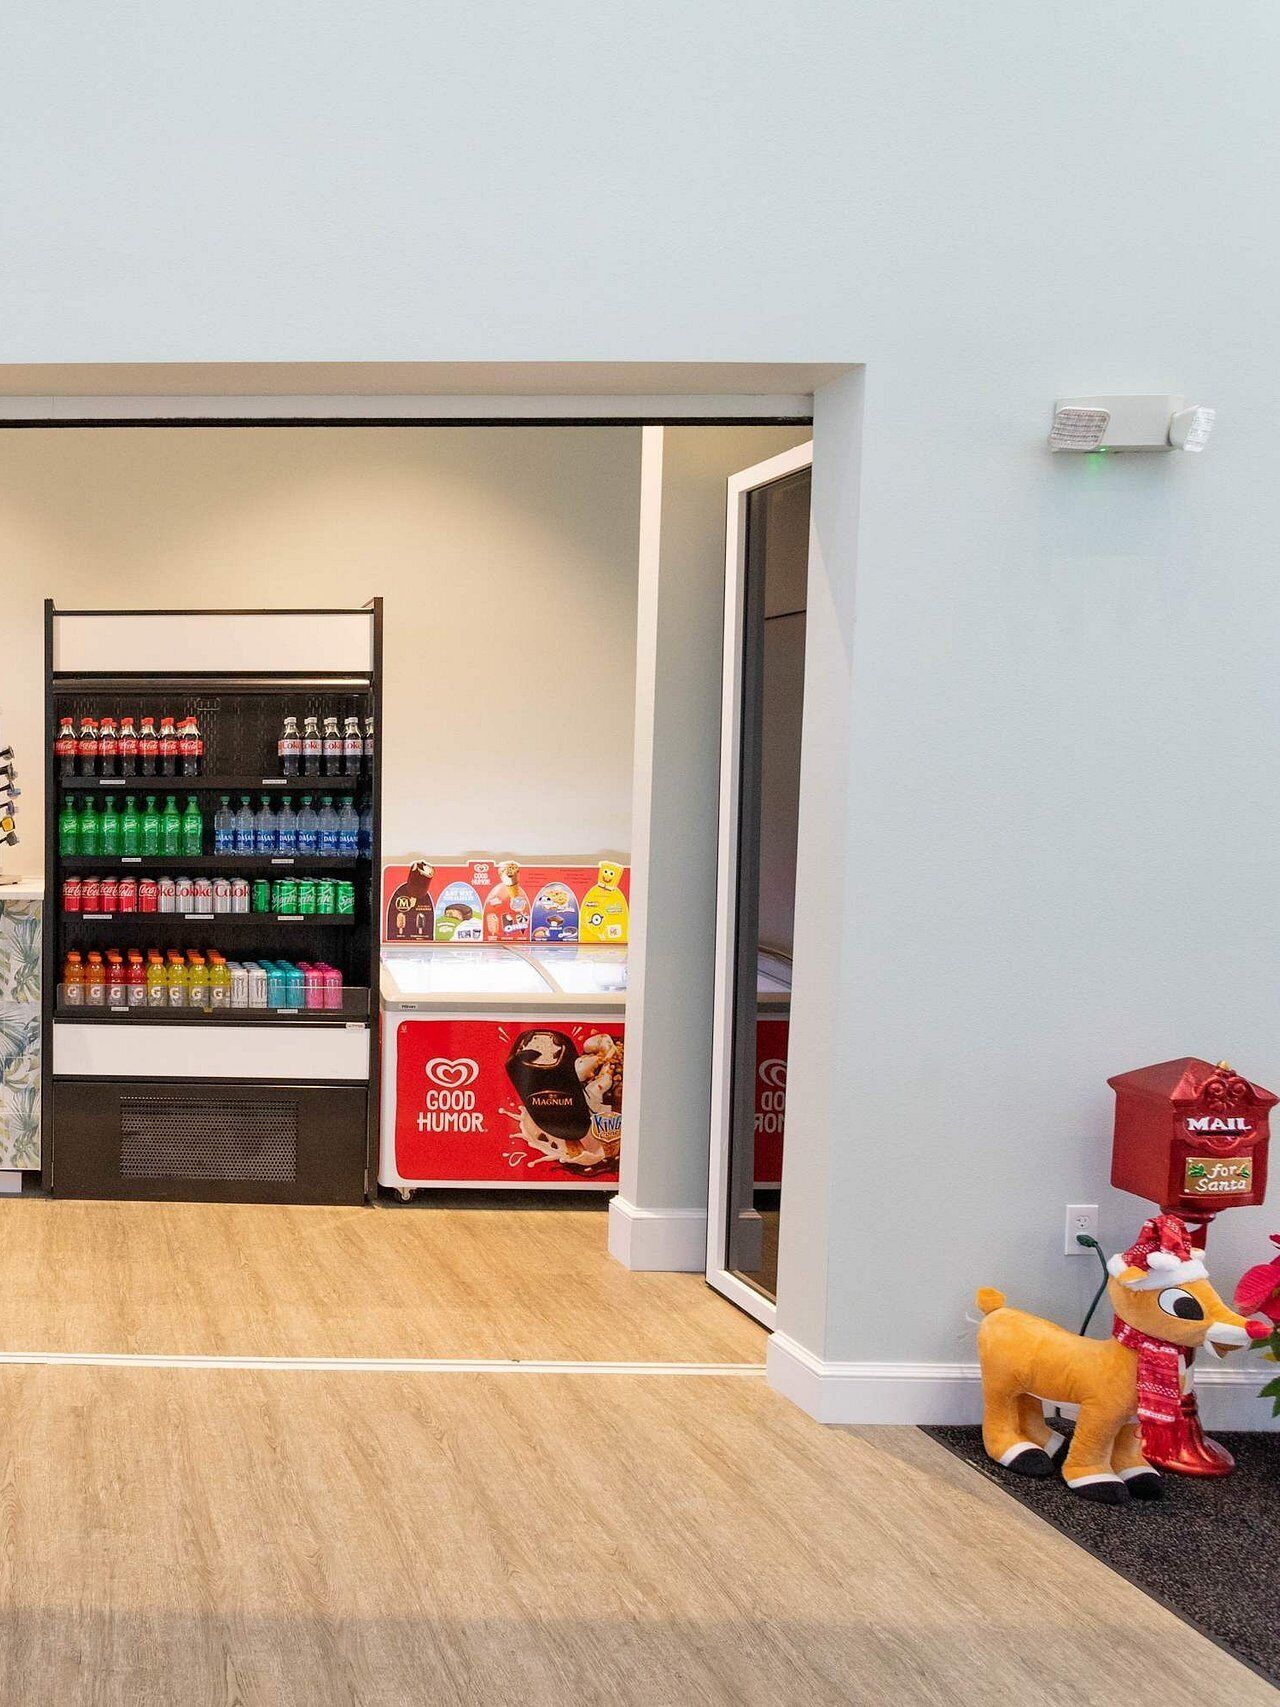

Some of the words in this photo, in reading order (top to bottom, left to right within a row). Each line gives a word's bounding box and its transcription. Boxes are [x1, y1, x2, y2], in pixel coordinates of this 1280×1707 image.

[67, 986, 77, 997] G
[91, 986, 101, 997] G
[111, 987, 121, 998] G
[134, 987, 144, 998] G
[152, 986, 161, 998] G
[170, 987, 179, 998] G
[192, 988, 202, 999] G
[213, 988, 224, 998] G
[426, 1090, 475, 1111] GOOD
[532, 1097, 573, 1106] MAGNUM
[417, 1111, 485, 1133] HUMOR
[1186, 1117, 1252, 1131] MAIL
[1207, 1163, 1237, 1179] for
[1195, 1178, 1247, 1192] Santa
